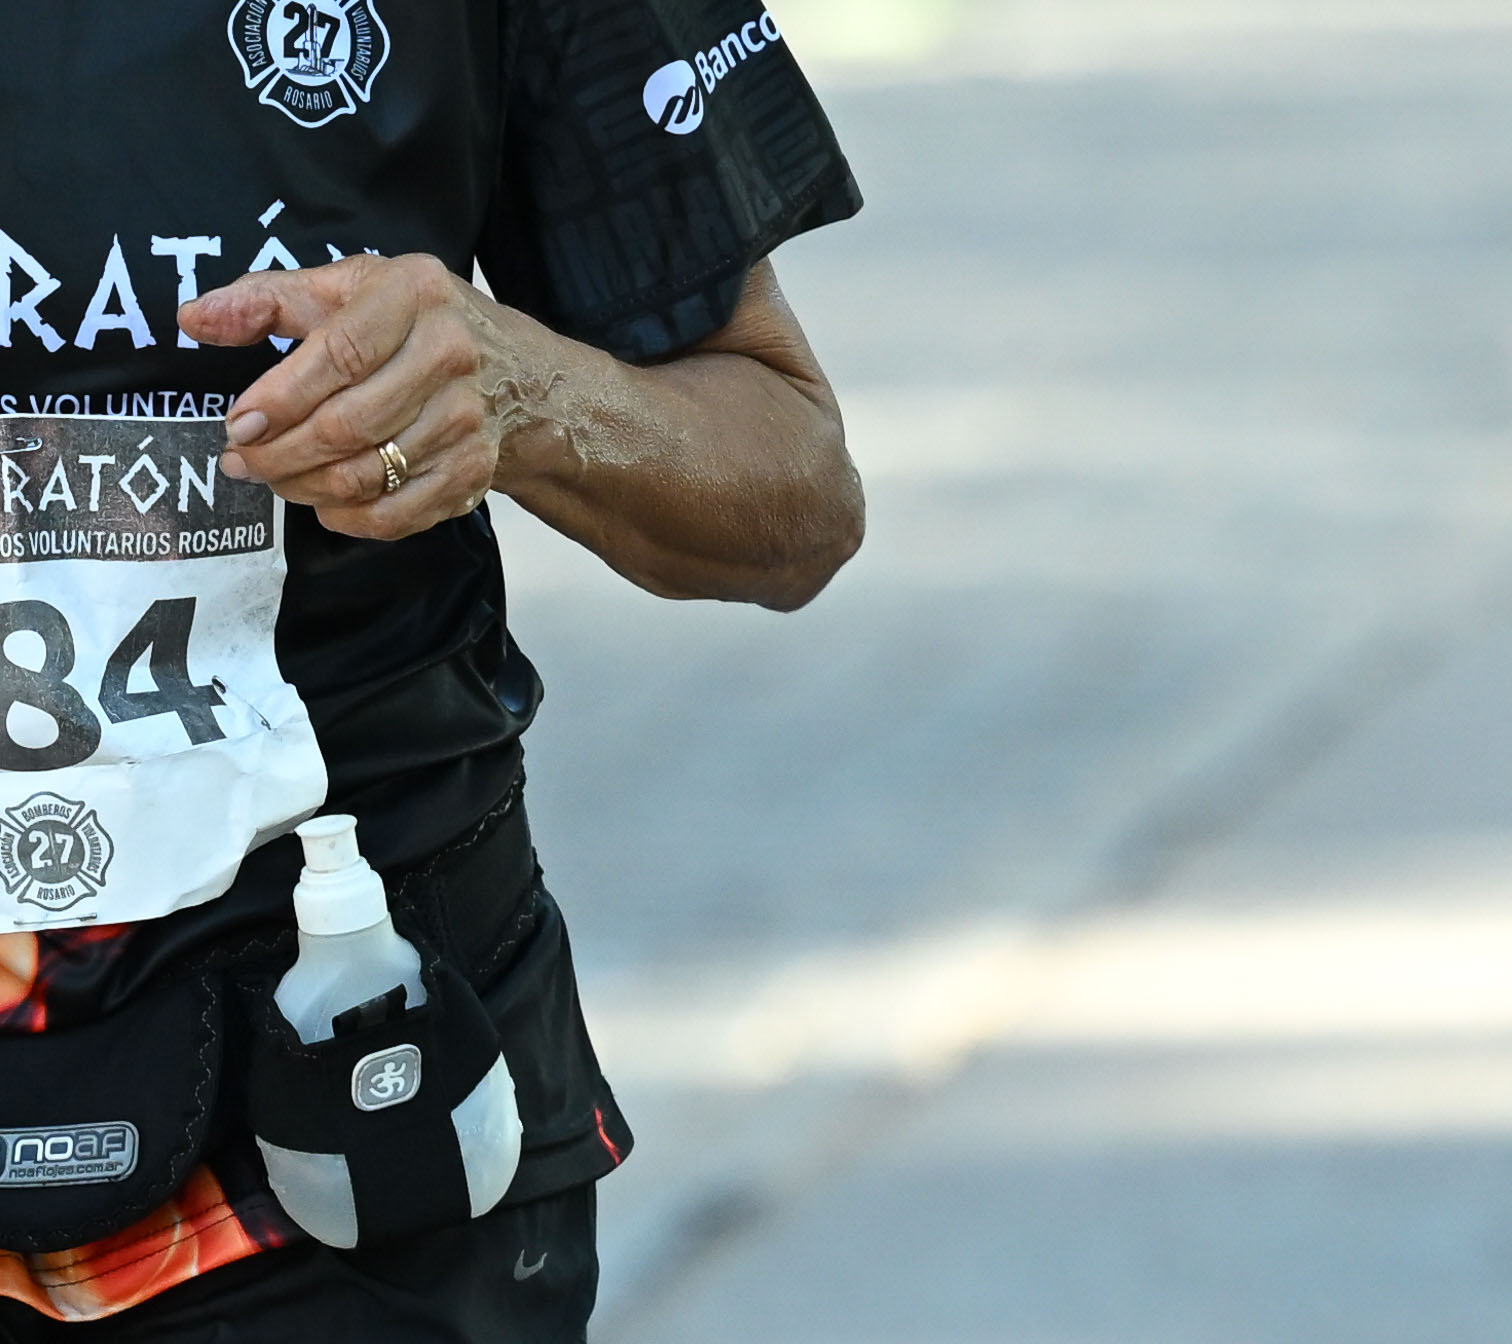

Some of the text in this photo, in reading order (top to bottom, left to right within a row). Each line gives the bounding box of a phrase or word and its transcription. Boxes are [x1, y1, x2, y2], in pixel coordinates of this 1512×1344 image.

[284, 1, 340, 59] 27
[351, 6, 373, 81] VOLUNTARIOS
[695, 10, 780, 94] Banco
[284, 86, 333, 110] ROSARIO
[28, 531, 170, 557] VOLUNTARIOS
[179, 523, 266, 554] ROSARIO
[21, 804, 72, 822] BOMBEROS
[29, 830, 74, 869] 27
[37, 884, 75, 900] ROSARIO
